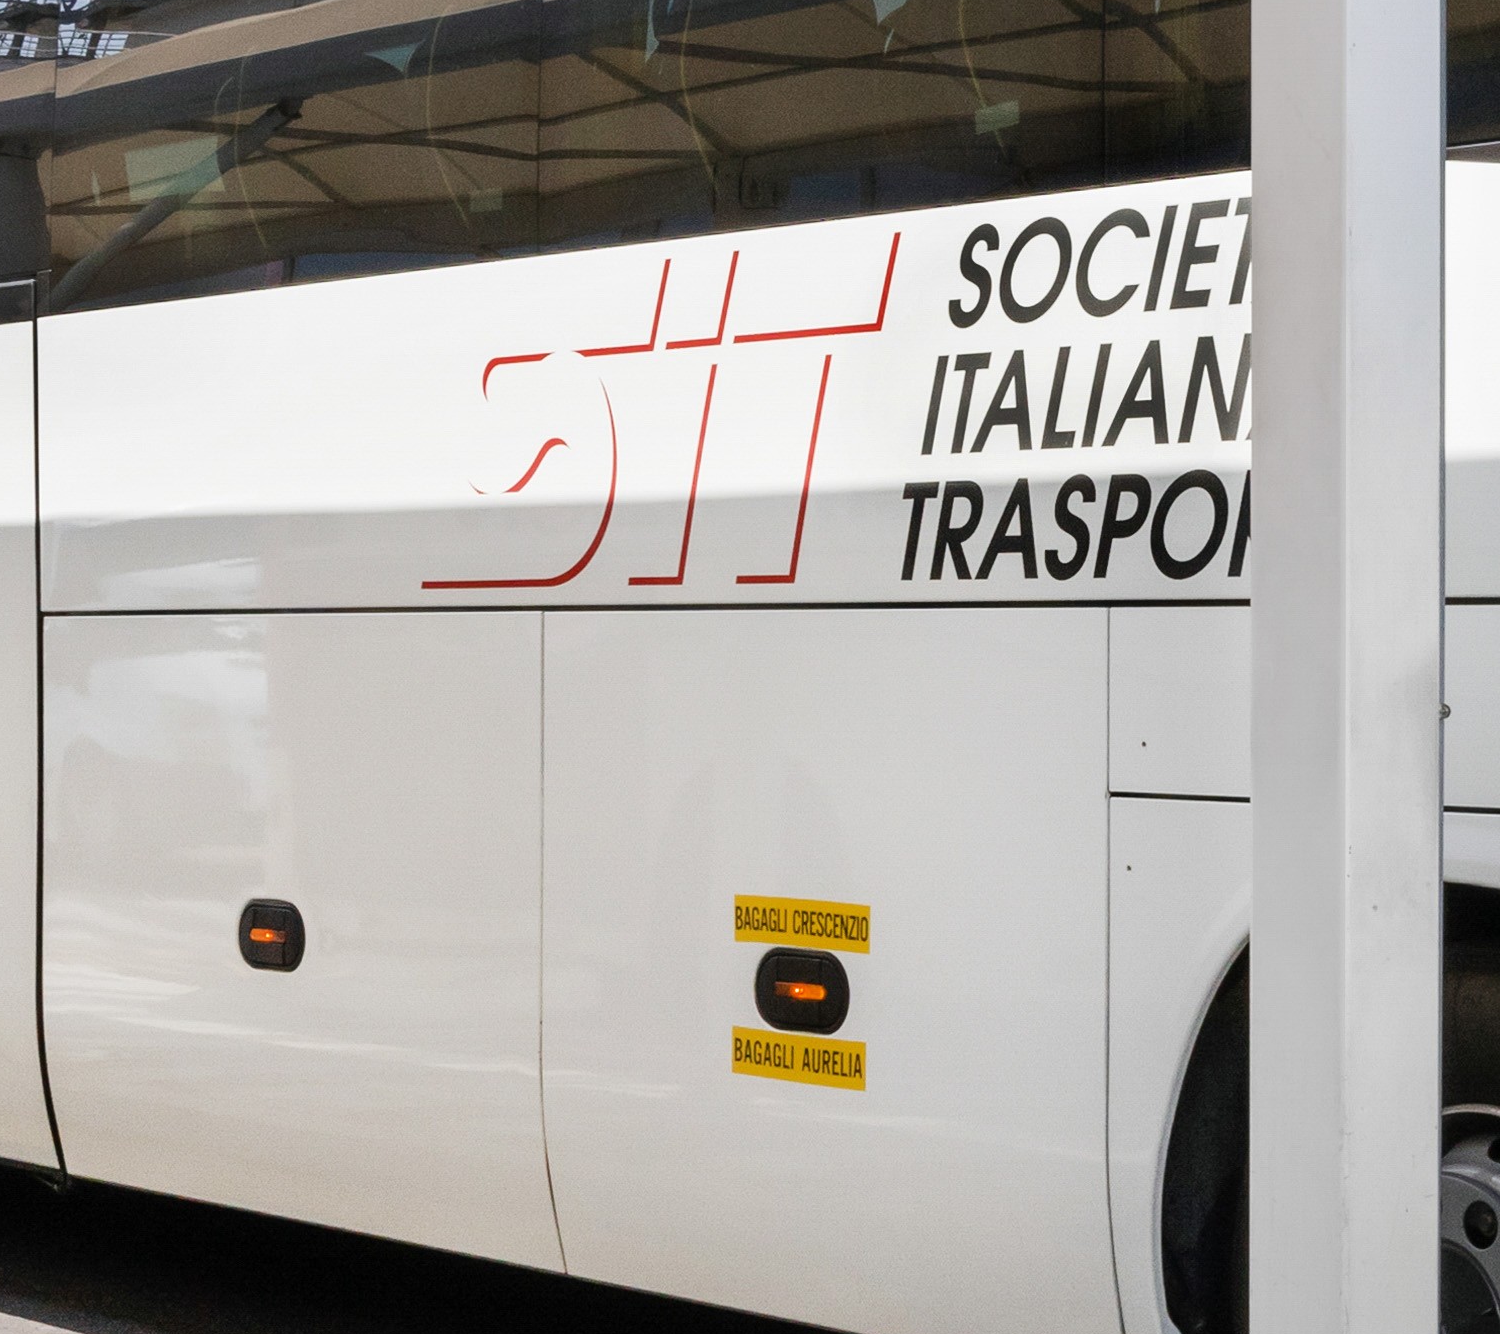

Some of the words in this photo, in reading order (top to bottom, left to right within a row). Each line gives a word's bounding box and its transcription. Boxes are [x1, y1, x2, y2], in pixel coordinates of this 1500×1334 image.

[948, 196, 1252, 329] SOCIET
[921, 332, 1252, 457] ITALIAN
[734, 905, 788, 935] BAGAGLI
[792, 909, 870, 943] CRESCENZIO
[733, 1037, 795, 1070] BAGAGLI
[801, 1046, 863, 1080] AURELIA
